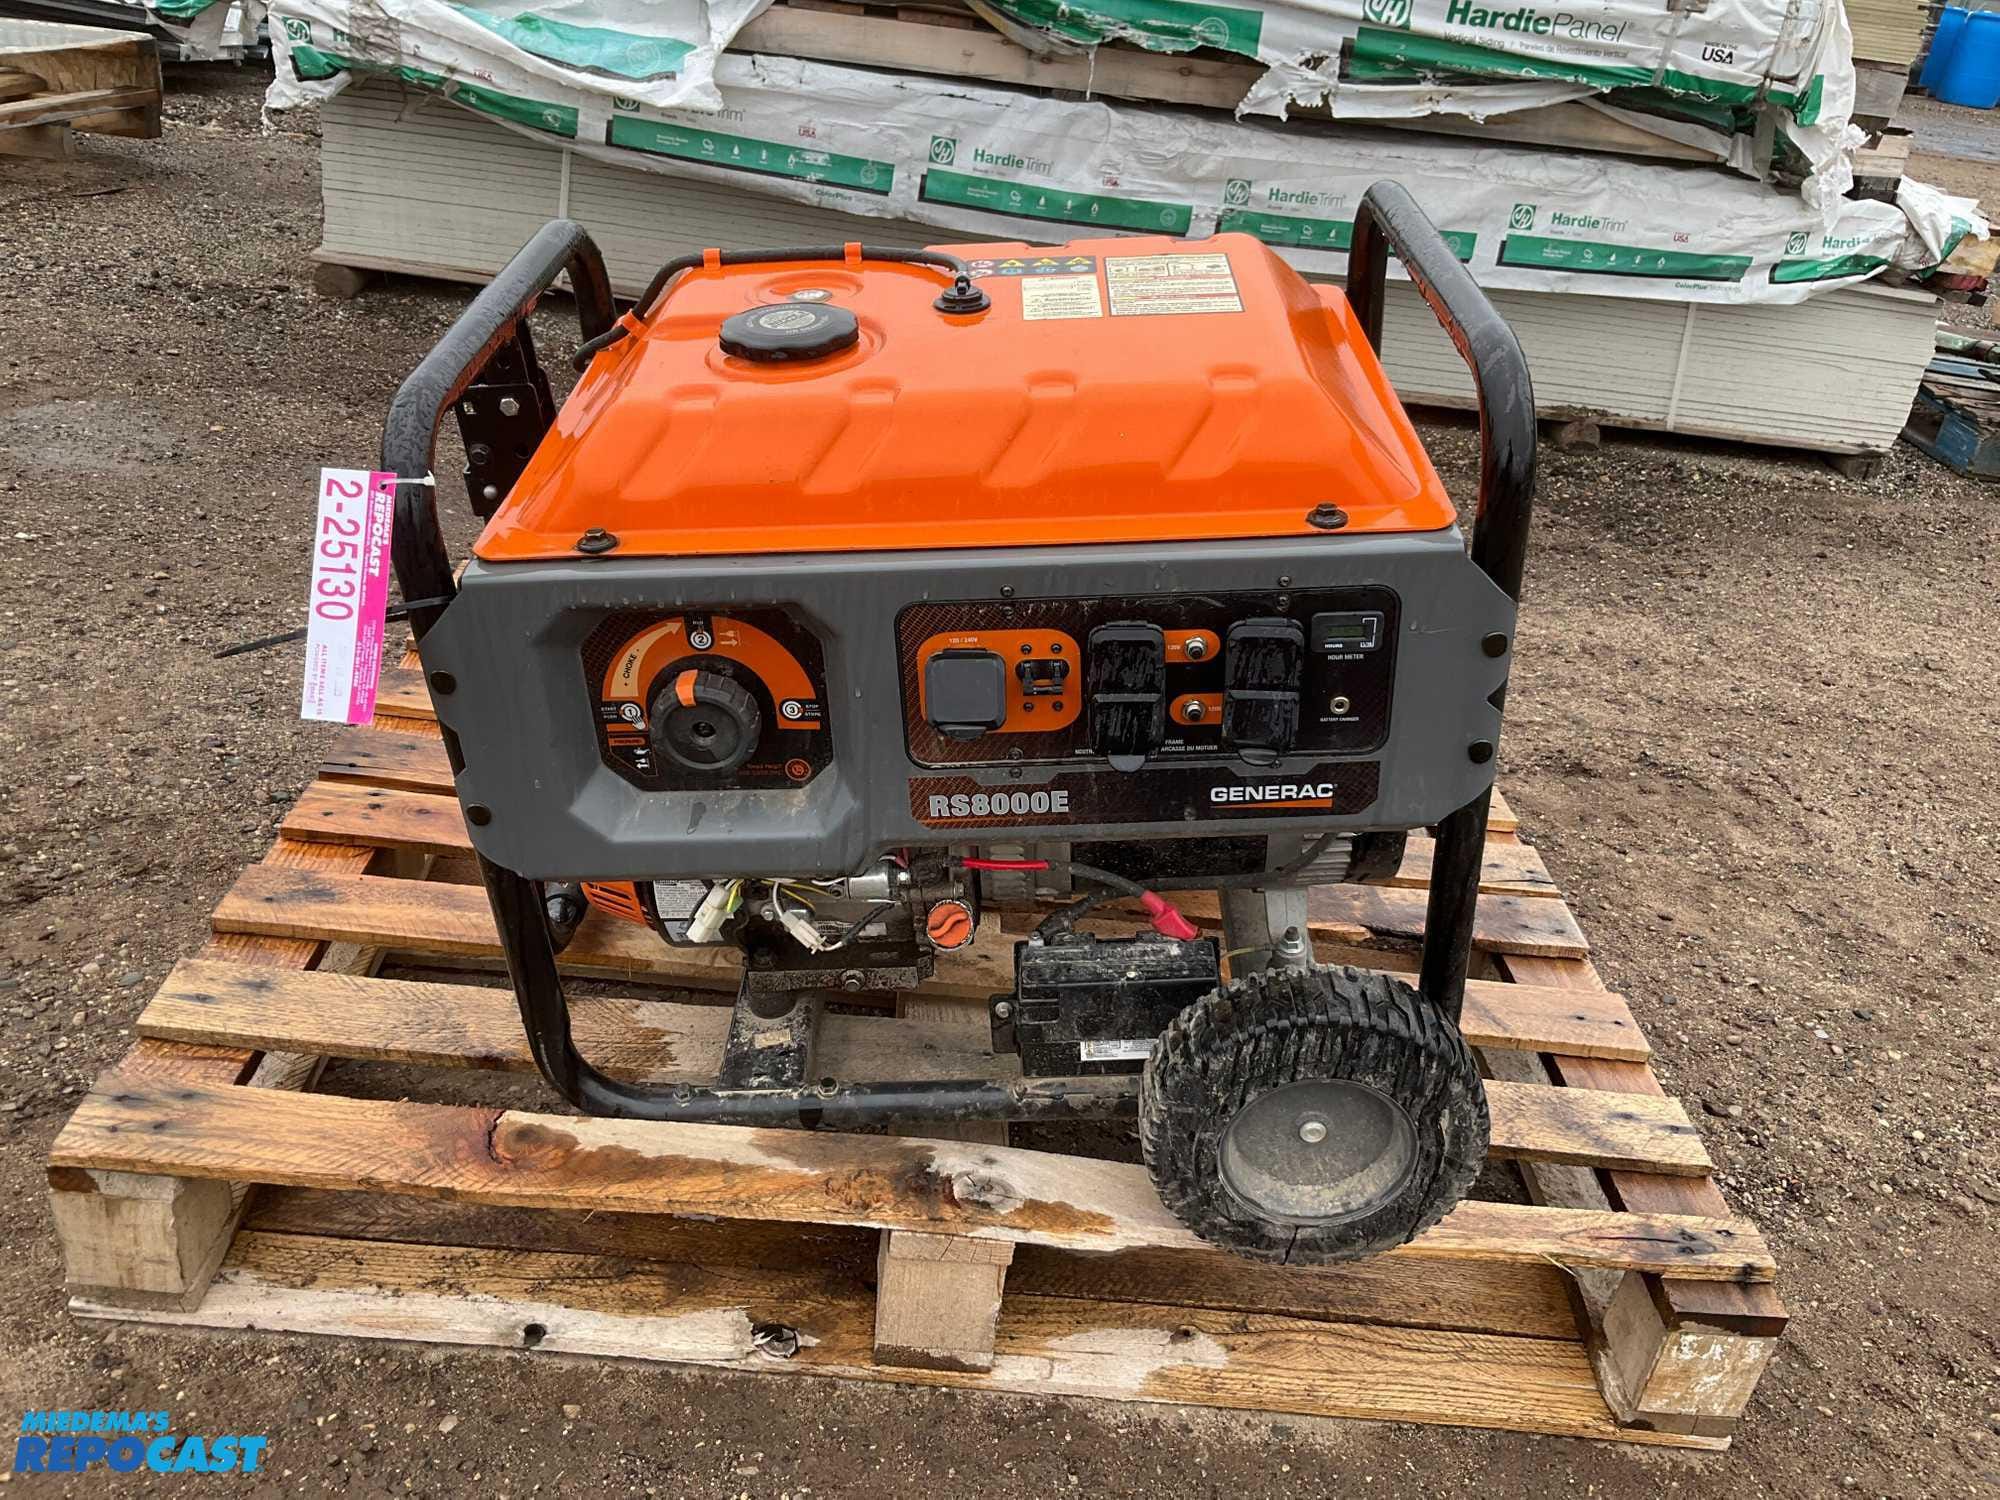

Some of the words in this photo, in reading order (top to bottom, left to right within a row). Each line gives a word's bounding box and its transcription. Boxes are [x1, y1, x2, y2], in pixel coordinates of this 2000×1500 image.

[1446, 0, 1628, 42] HardiePanel
[1701, 46, 1733, 64] USA
[974, 147, 1051, 175] HardieTrim
[1268, 187, 1343, 208] HardieTrim
[1551, 211, 1625, 232] HardieTrim
[369, 491, 386, 577] REPOCAST
[316, 478, 363, 621] 2-25130
[697, 635, 705, 644] 2
[624, 654, 637, 679] CHOKE
[789, 705, 796, 714] 3
[929, 790, 1069, 817] RS8000E
[1210, 783, 1334, 802] GENERAC
